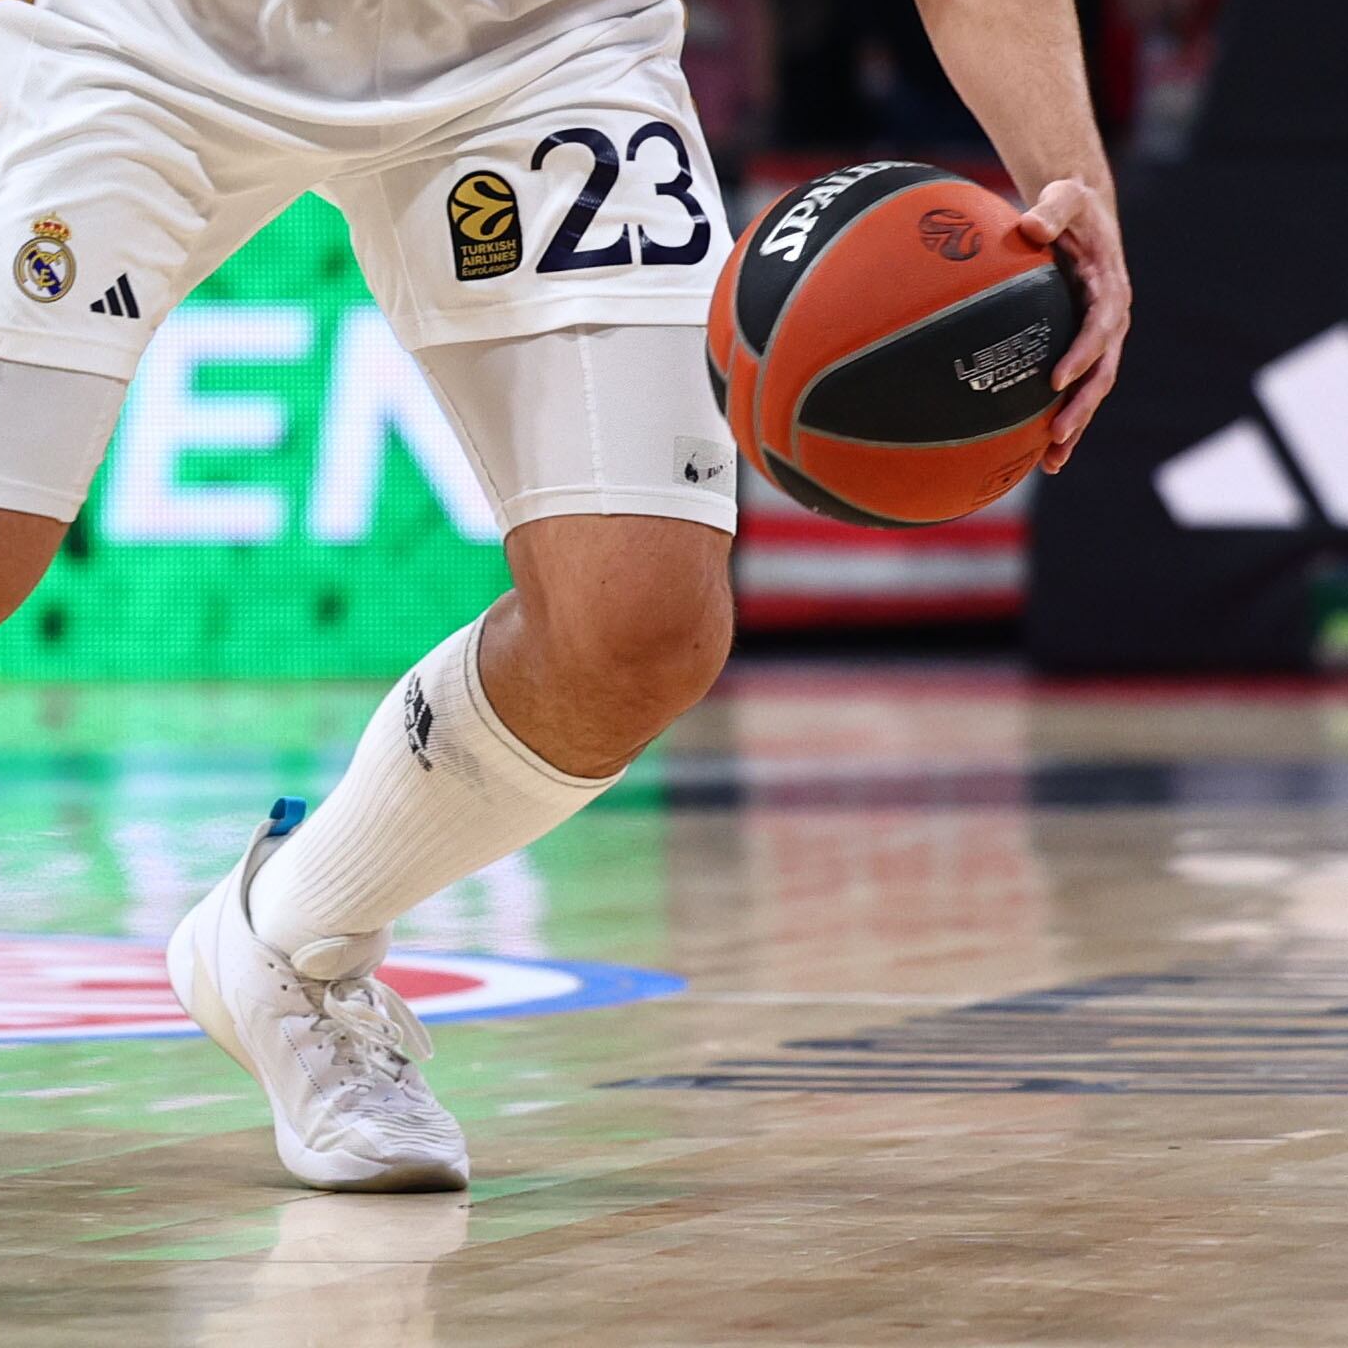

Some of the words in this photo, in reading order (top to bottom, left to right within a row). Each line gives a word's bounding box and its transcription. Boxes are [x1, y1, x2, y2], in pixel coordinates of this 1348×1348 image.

[530, 121, 712, 275] 23
[460, 239, 517, 256] TURKISH
[461, 250, 517, 267] AIRLINES
